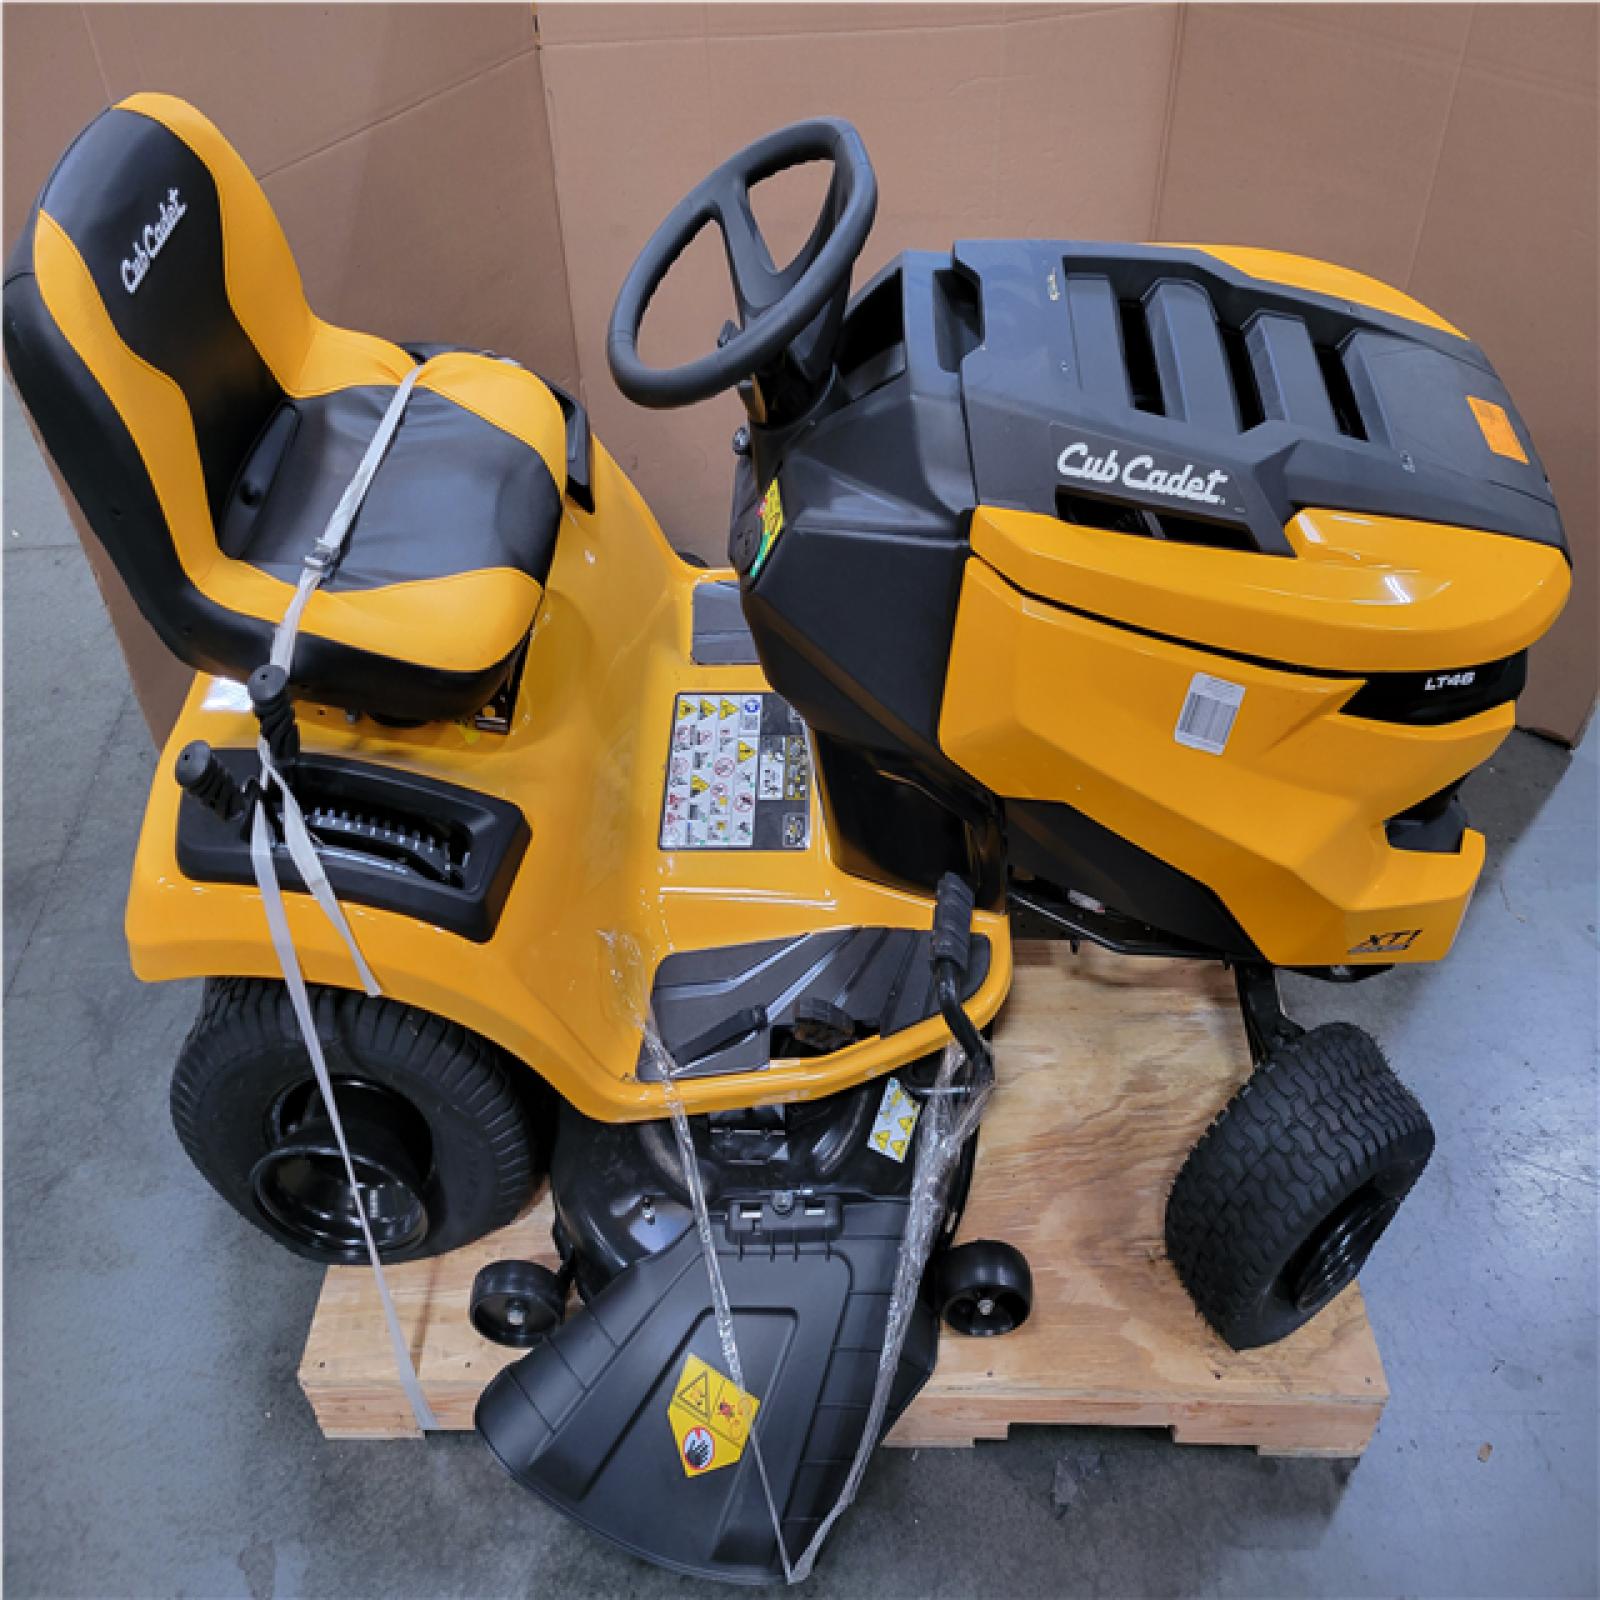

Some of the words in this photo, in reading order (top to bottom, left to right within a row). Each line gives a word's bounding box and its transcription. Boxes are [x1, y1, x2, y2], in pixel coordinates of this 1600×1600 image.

[121, 241, 150, 294] Cub
[143, 188, 188, 258] Cadet
[1057, 442, 1120, 483] Cub
[1121, 454, 1228, 505] Cadet
